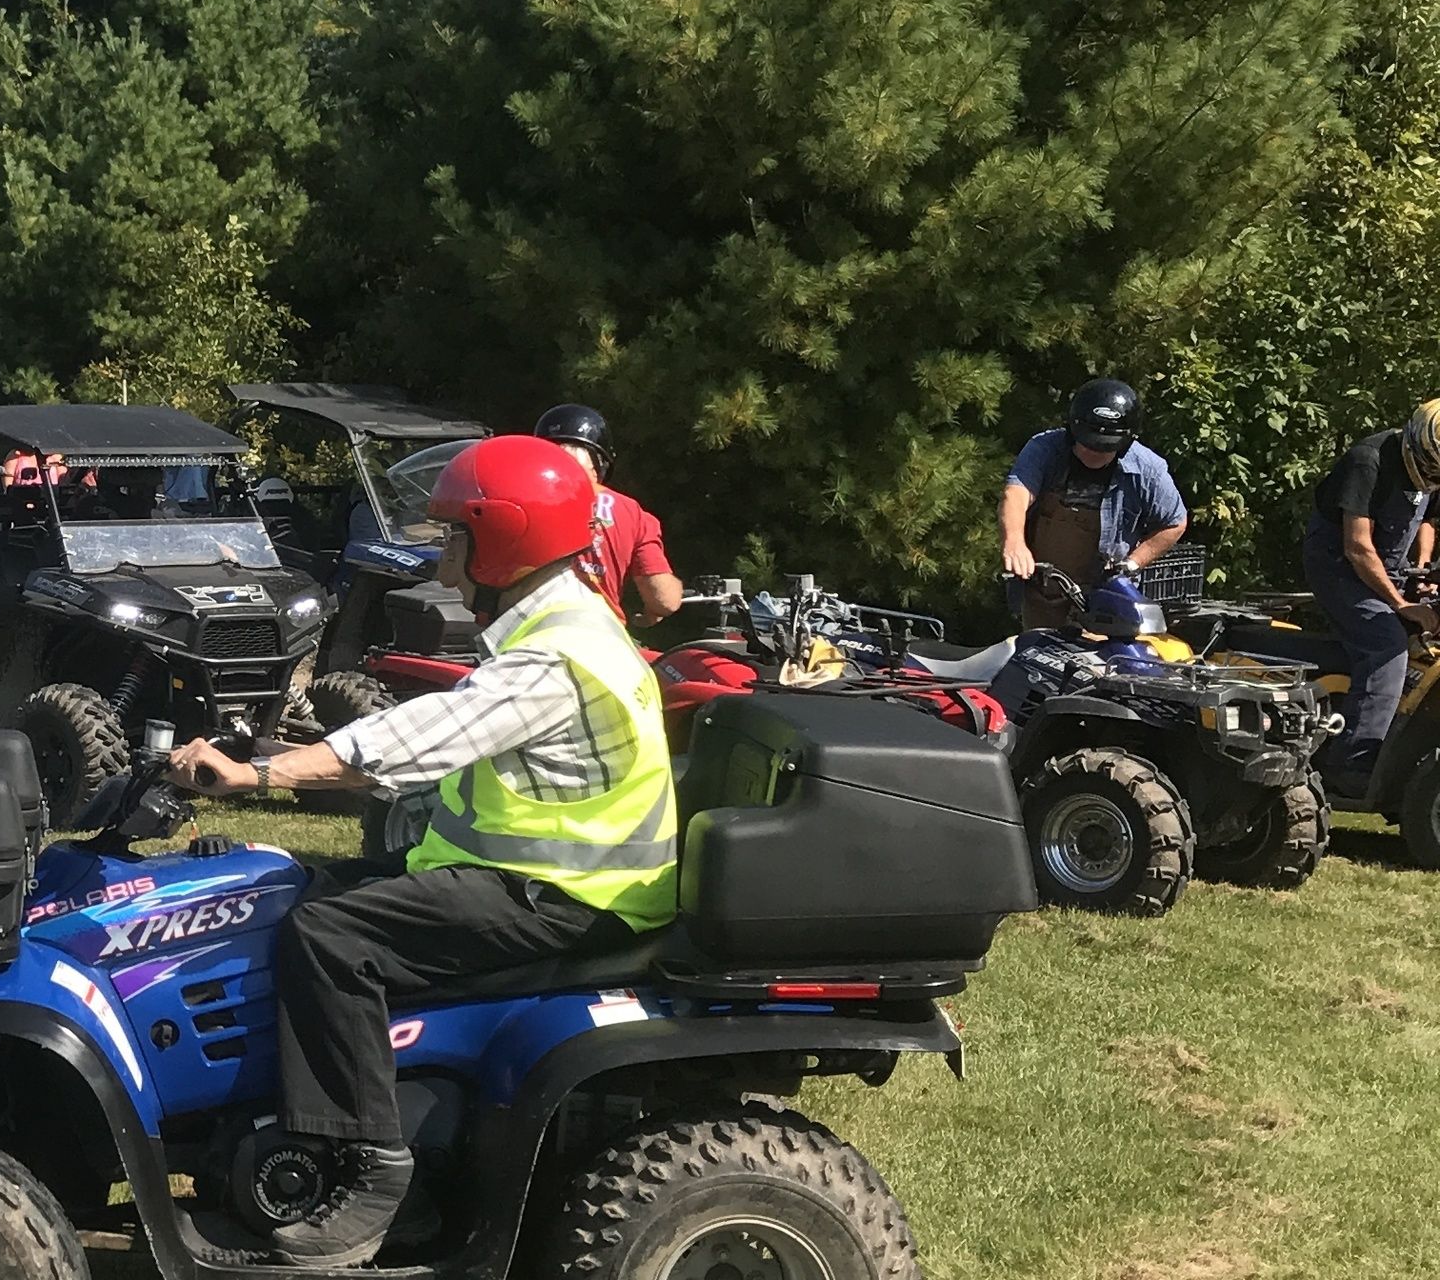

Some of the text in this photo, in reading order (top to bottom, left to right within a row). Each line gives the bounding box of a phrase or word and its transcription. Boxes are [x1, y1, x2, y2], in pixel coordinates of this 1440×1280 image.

[367, 545, 417, 567] 900
[26, 876, 156, 925] POLARIS
[98, 892, 260, 958] XPRESS
[258, 1149, 319, 1183] AUTOMATIC
